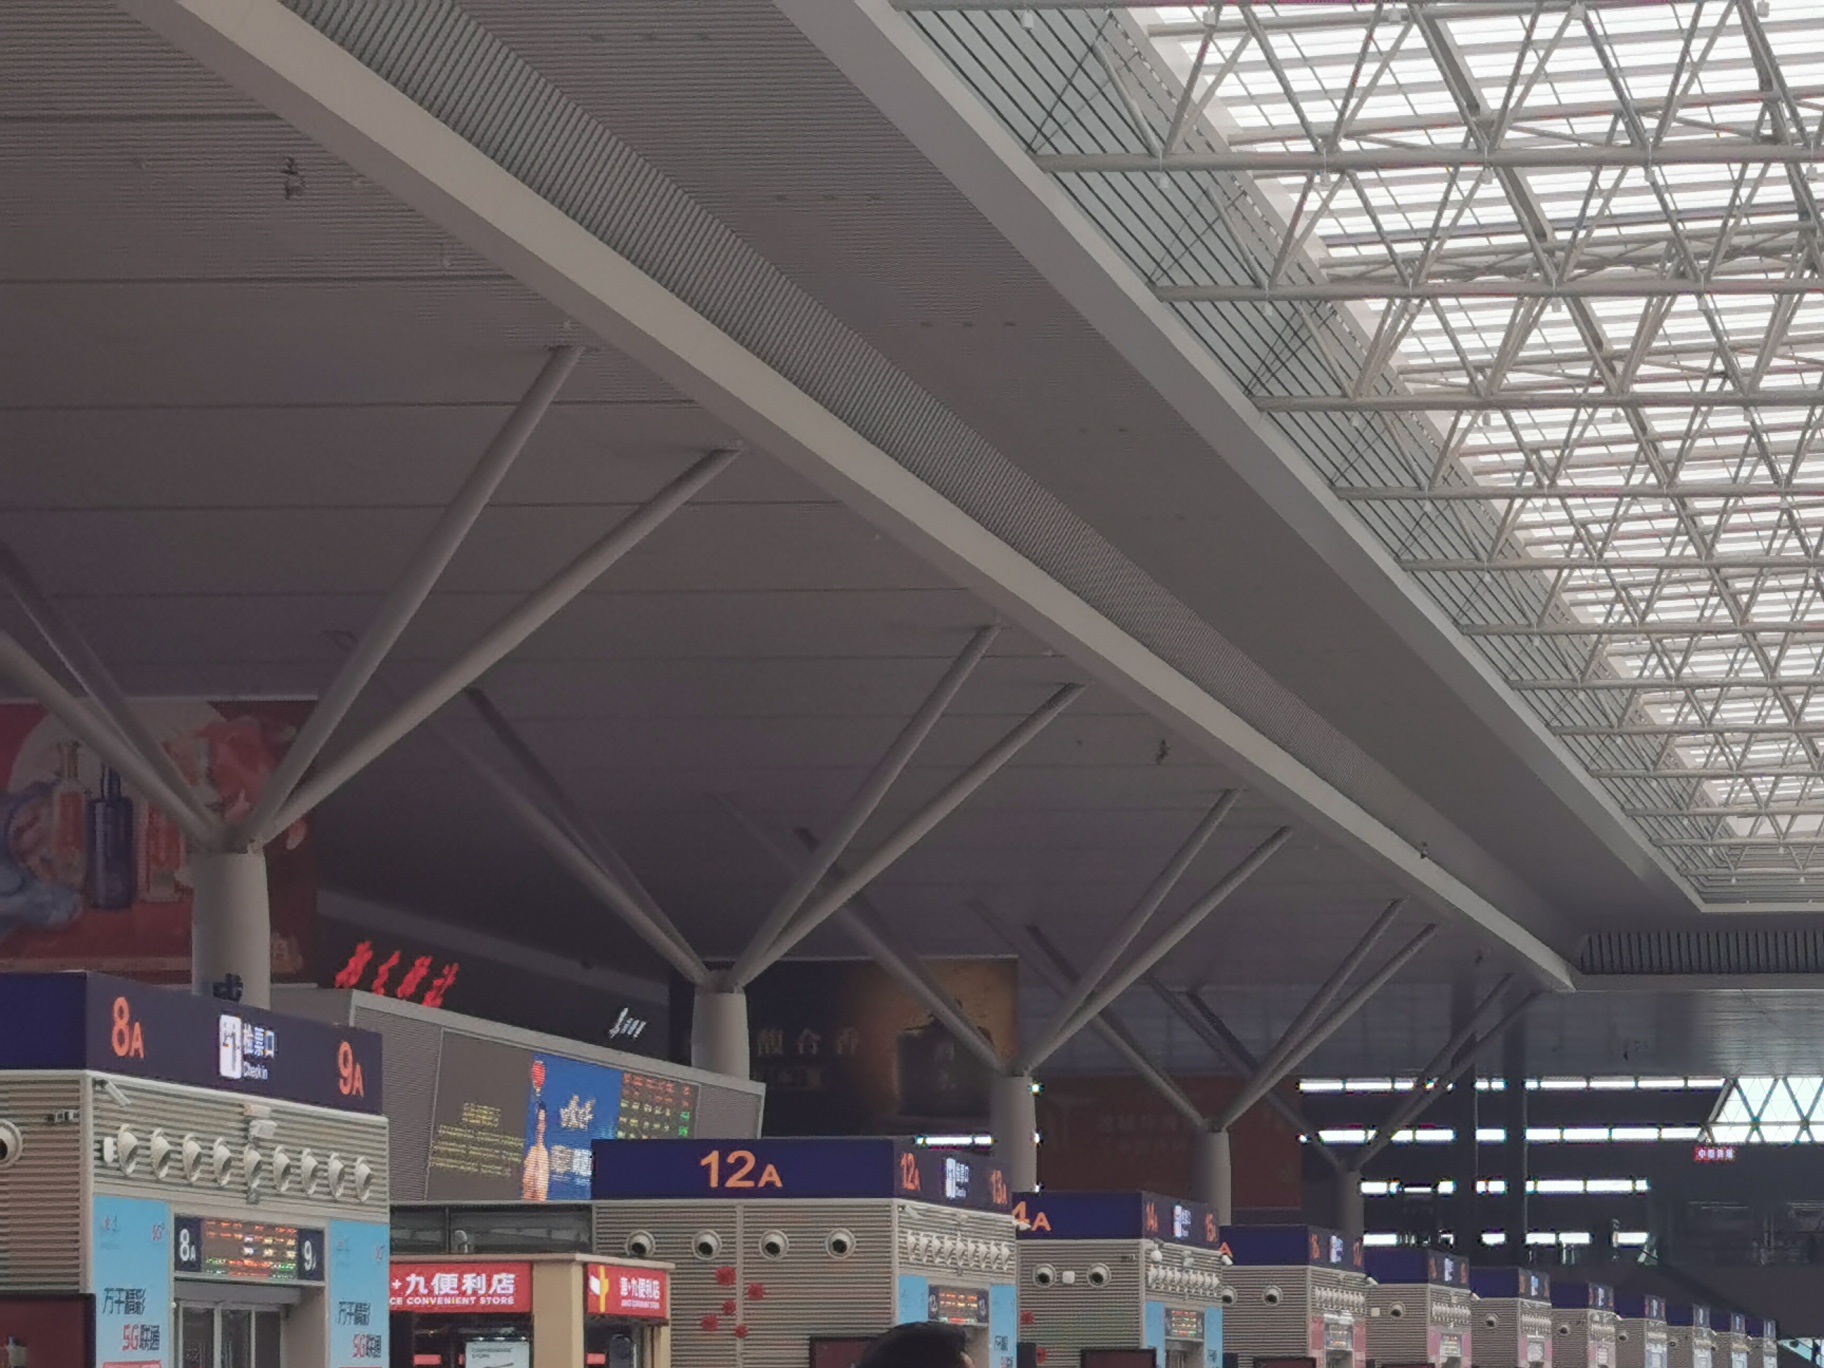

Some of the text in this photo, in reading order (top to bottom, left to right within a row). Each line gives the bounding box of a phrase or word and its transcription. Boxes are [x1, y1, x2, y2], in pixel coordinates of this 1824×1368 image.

[112, 997, 144, 1059] 8A
[338, 1041, 364, 1097] 9A
[700, 1150, 783, 1188] 12A
[900, 1153, 921, 1191] 12A
[1012, 1201, 1051, 1231] 4A
[179, 1228, 196, 1262] 8A
[407, 1297, 476, 1306] CONVENIENT
[480, 1297, 515, 1306] STORE
